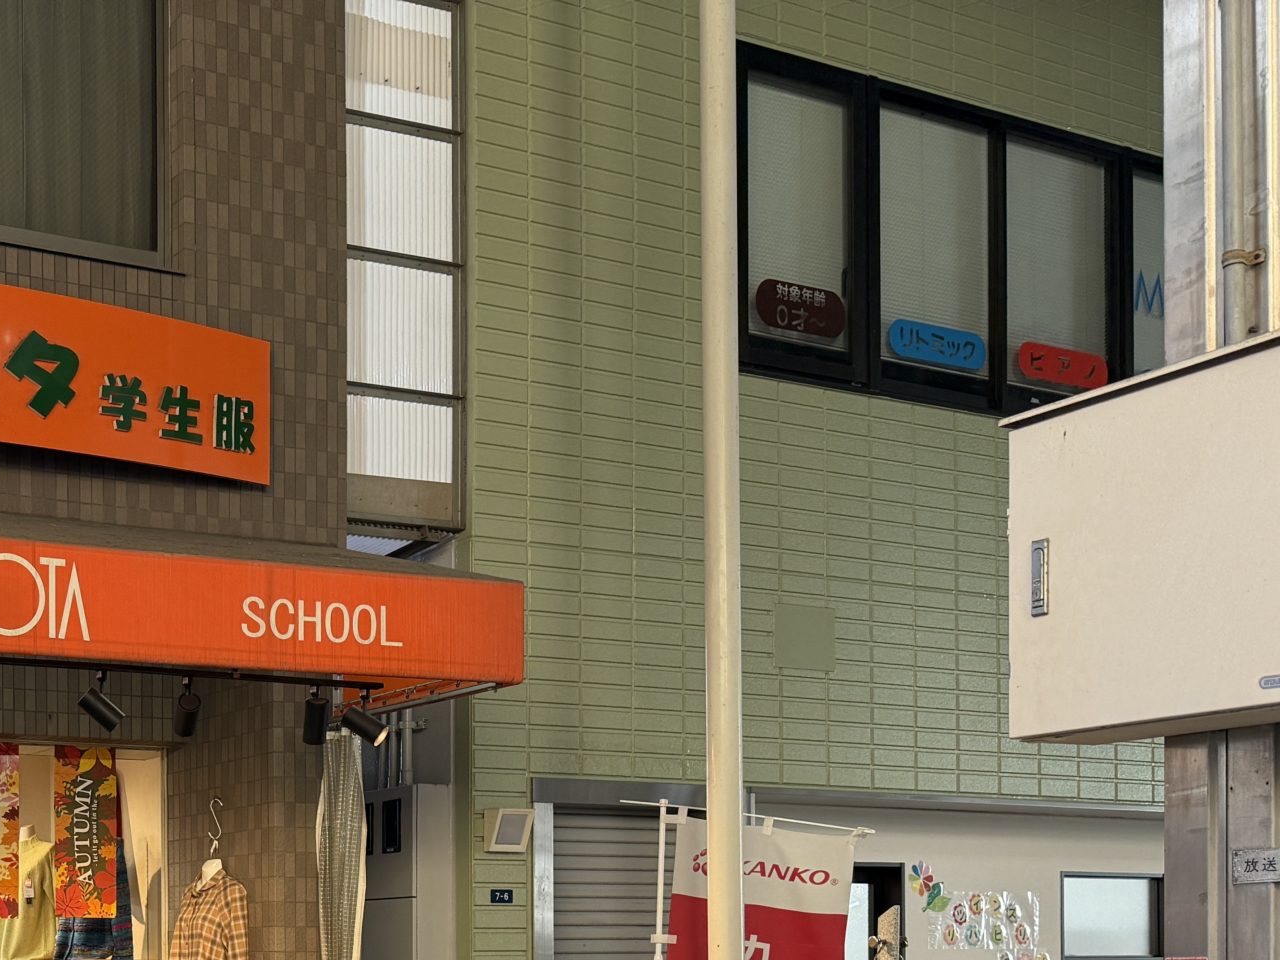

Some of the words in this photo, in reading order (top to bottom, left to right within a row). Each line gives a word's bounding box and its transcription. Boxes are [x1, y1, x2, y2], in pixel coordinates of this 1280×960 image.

[776, 283, 826, 307] 対象年齢
[900, 326, 976, 361] リトミック
[98, 374, 256, 454] 学生服
[241, 596, 404, 647] SCHOOL
[74, 776, 94, 886] AUTUMN
[742, 860, 830, 886] ANKO
[1244, 857, 1279, 873] 放送
[495, 892, 509, 901] 7-6
[956, 899, 1017, 921] ツインス
[947, 929, 1027, 942] リハビリ
